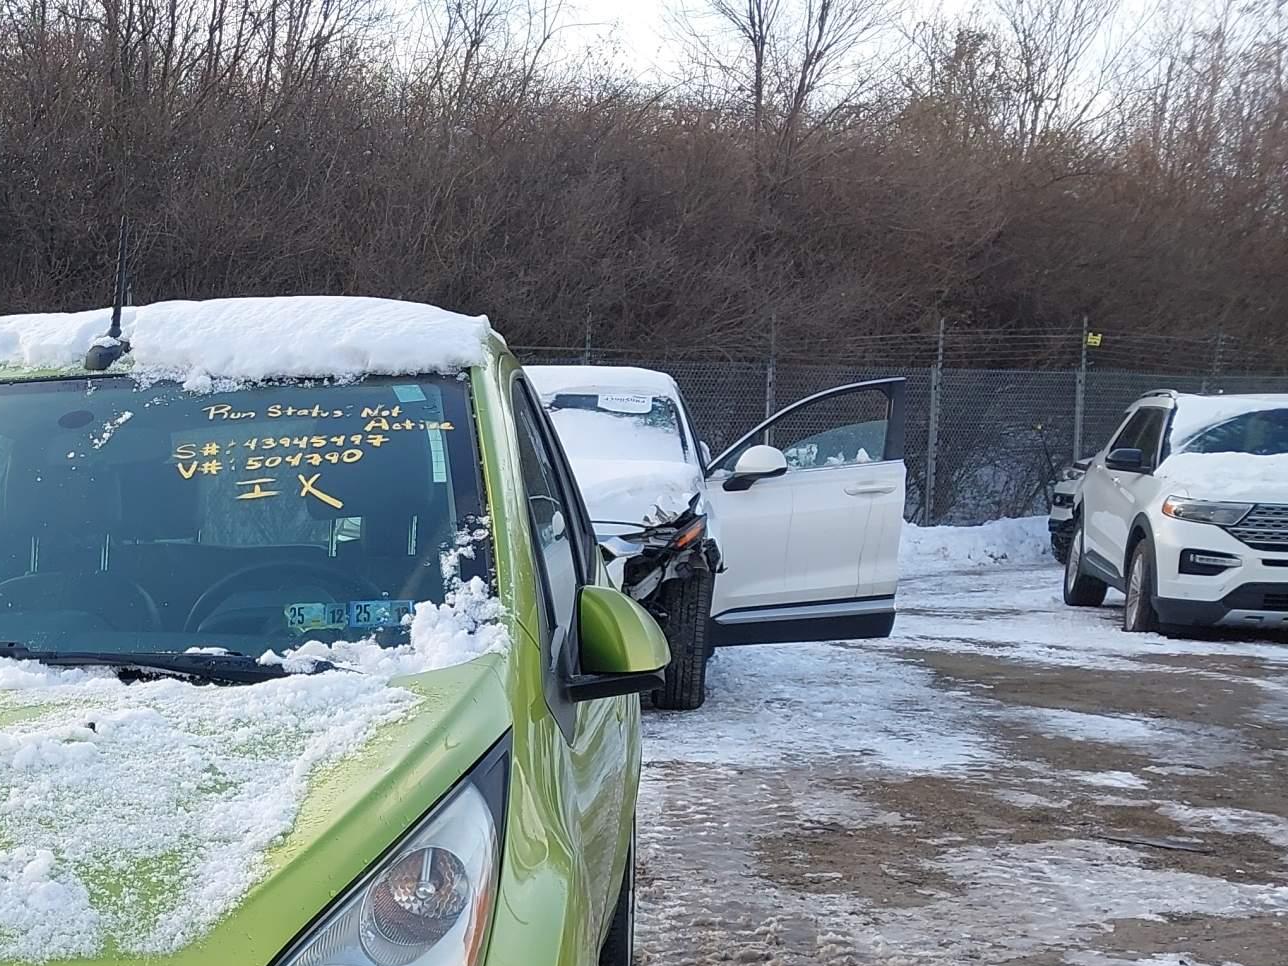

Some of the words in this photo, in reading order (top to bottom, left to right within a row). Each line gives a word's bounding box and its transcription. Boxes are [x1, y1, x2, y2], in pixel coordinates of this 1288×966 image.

[202, 404, 256, 420] Run
[360, 402, 404, 418] Not
[363, 416, 456, 432] Active
[243, 433, 391, 450] 43945497
[245, 448, 364, 471] 504790
[289, 606, 305, 626] 25
[329, 608, 345, 625] 12
[355, 603, 371, 624] 25
